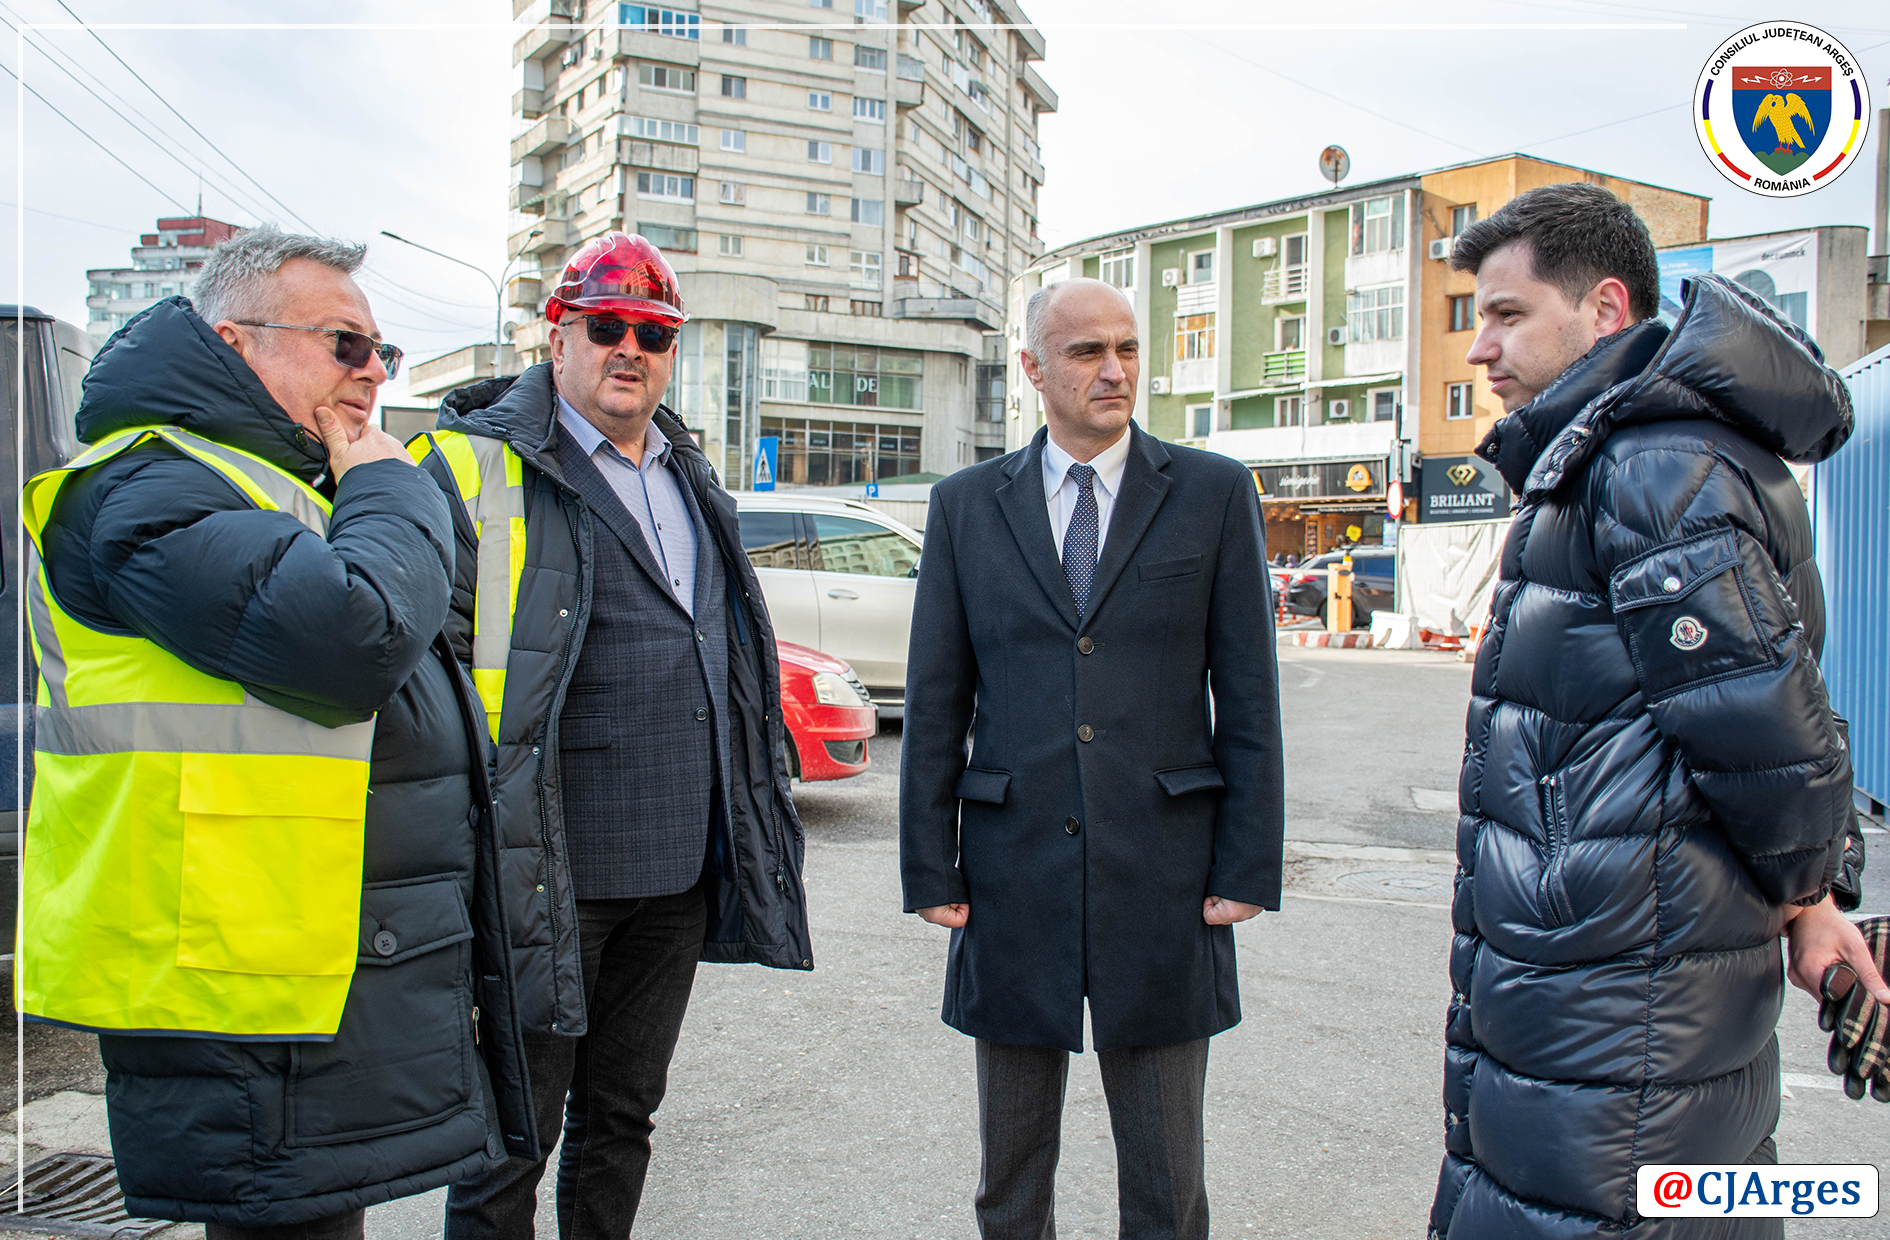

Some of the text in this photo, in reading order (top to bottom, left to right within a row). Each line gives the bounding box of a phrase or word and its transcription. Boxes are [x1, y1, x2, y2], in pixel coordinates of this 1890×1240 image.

[809, 374, 878, 393] AL DE
[868, 486, 876, 497] P
[1429, 493, 1495, 508] BRILIANT
